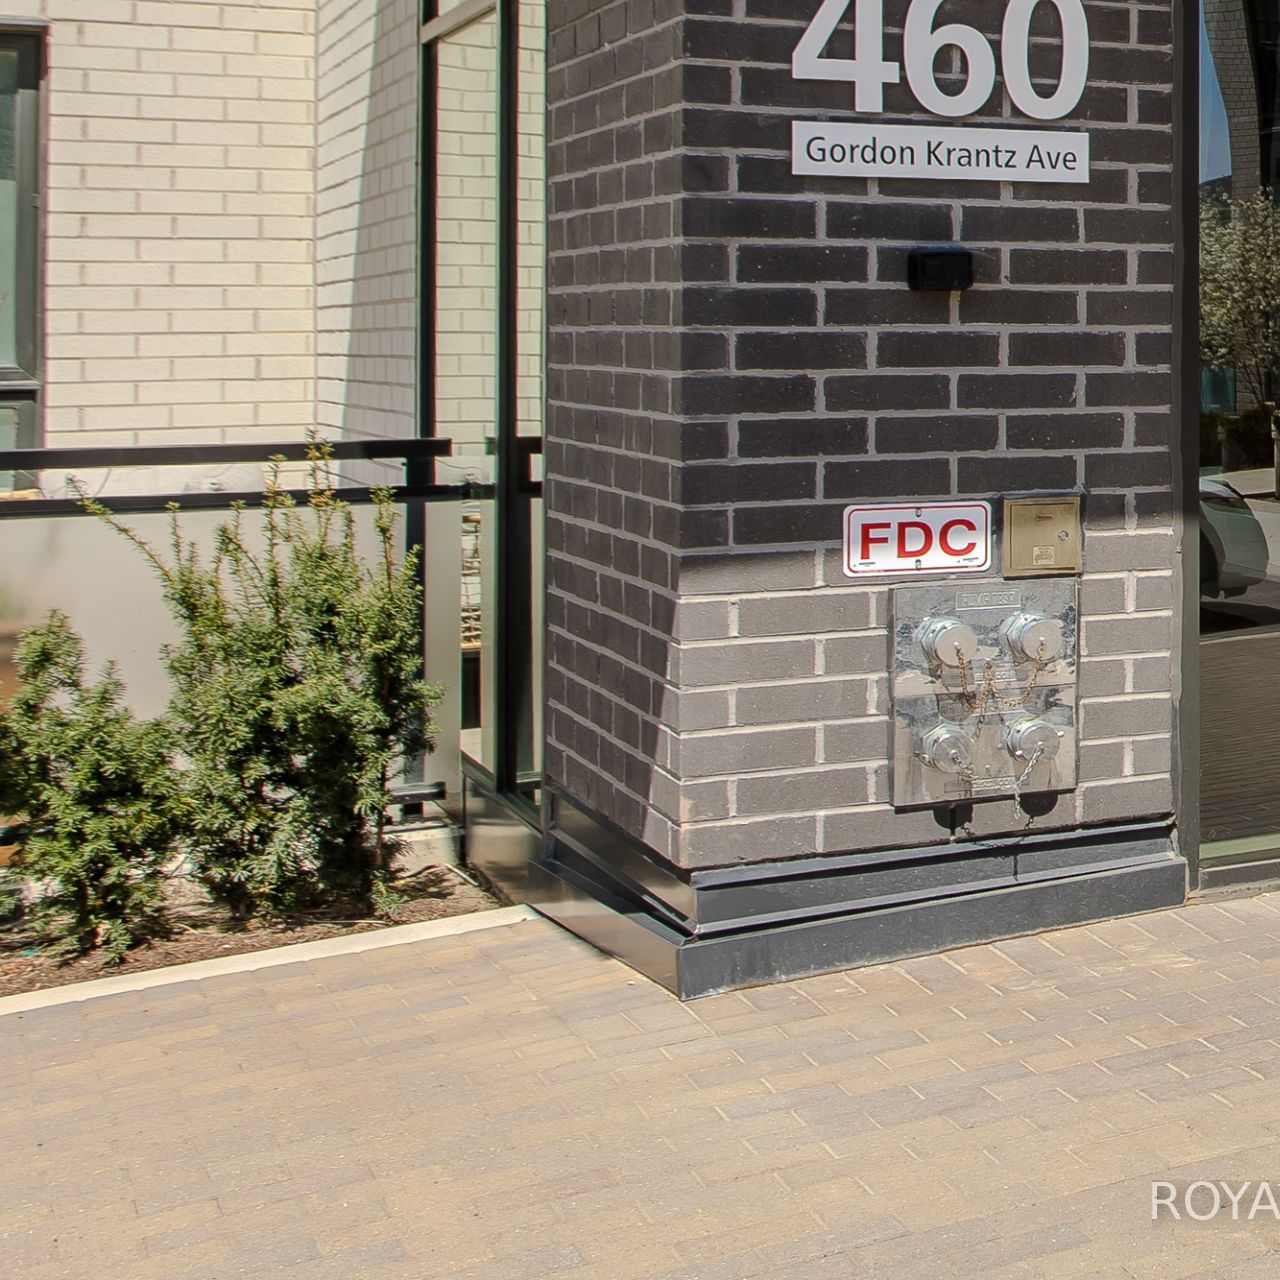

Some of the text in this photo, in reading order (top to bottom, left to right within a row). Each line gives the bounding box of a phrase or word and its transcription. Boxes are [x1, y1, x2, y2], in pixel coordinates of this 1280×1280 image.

[805, 136, 1078, 171] Gordon Krantz Ave
[861, 519, 977, 561] FDC
